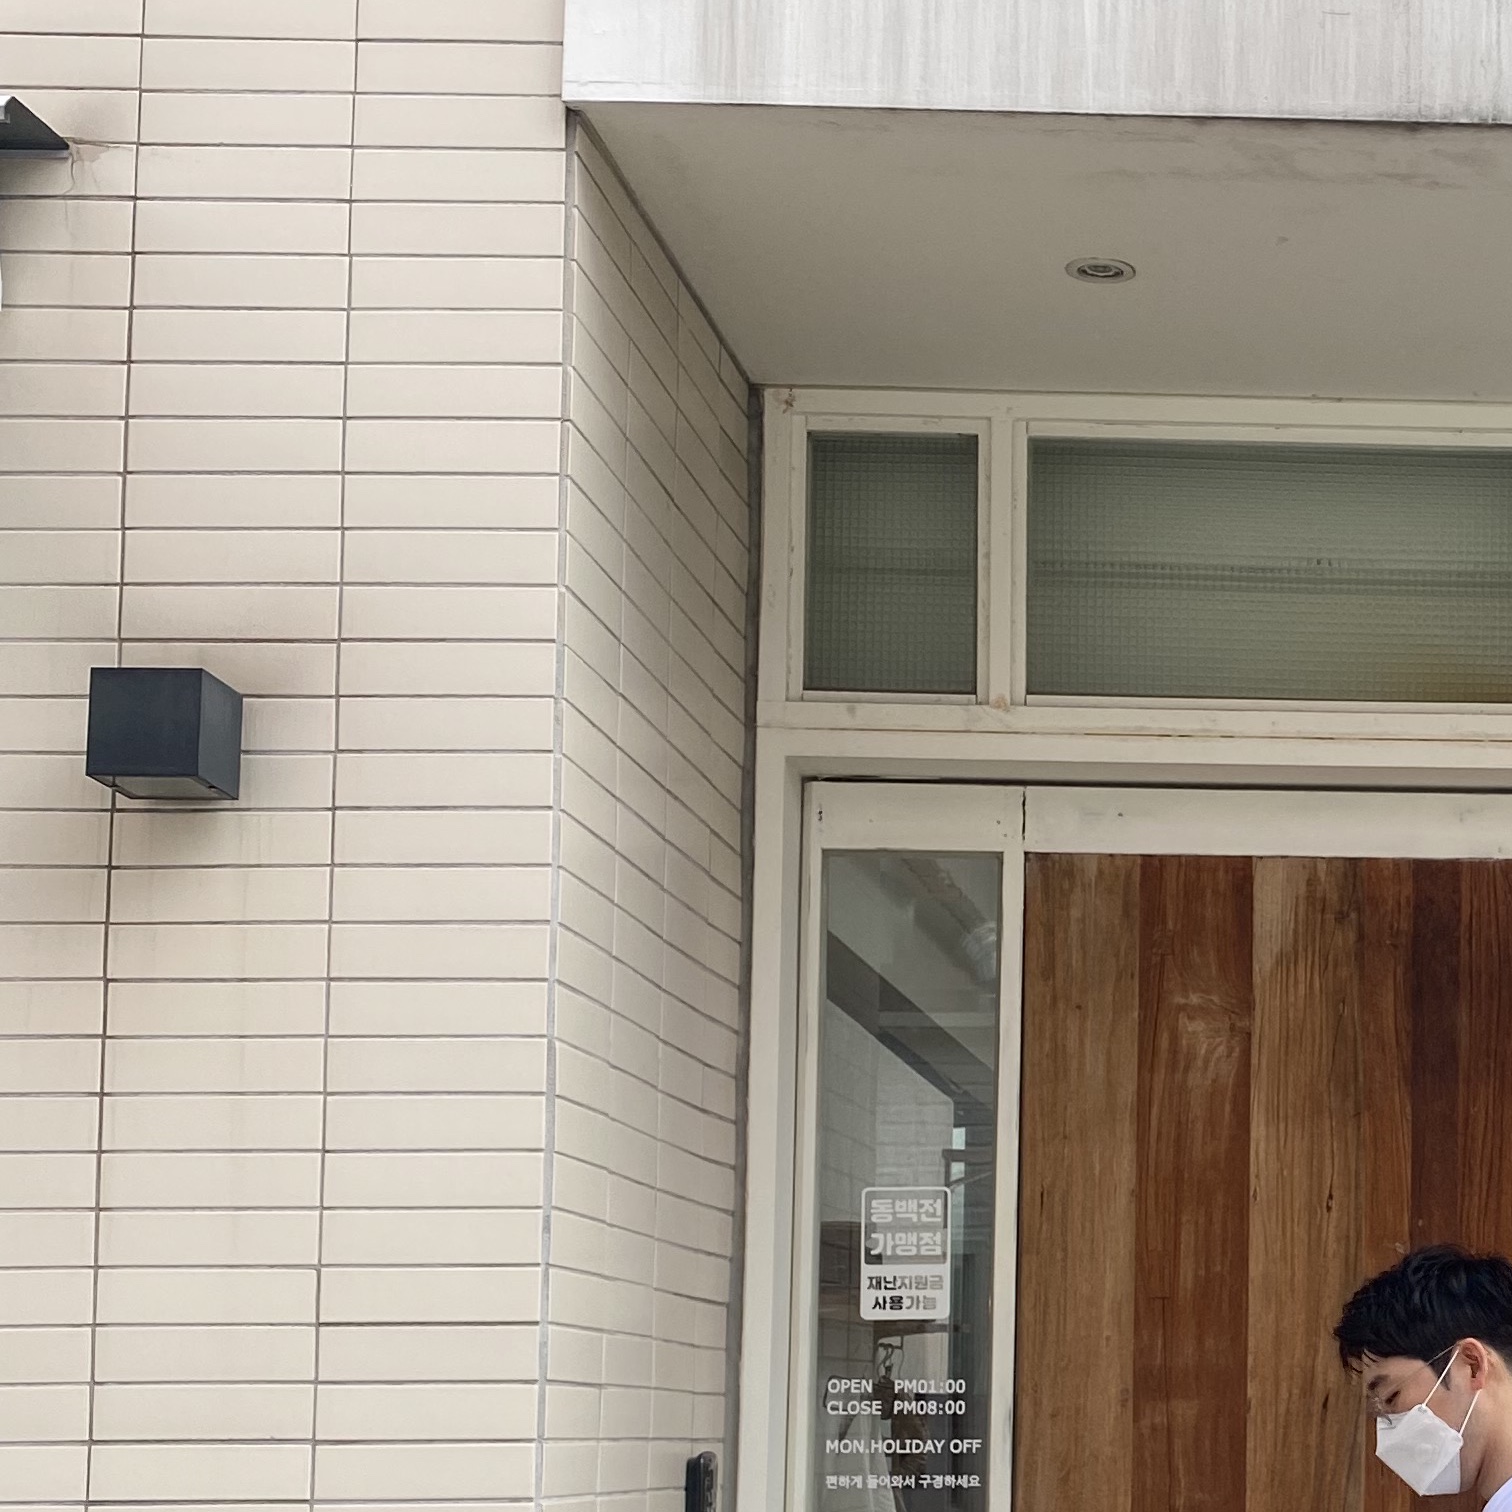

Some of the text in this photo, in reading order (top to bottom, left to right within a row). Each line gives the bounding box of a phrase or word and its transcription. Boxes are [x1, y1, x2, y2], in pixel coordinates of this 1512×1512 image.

[870, 1199, 942, 1223] 동백전
[870, 1231, 942, 1256] 가맹점
[866, 1275, 944, 1291] 재난지원금
[871, 1295, 937, 1310] 사용가능
[827, 1379, 966, 1394] OPEN PM01:00
[826, 1400, 966, 1415] CLOSE PM08:00
[825, 1439, 983, 1454] MON.HOLIDAY OFF
[825, 1475, 981, 1489] 편하게 들어와서 구경하세요
